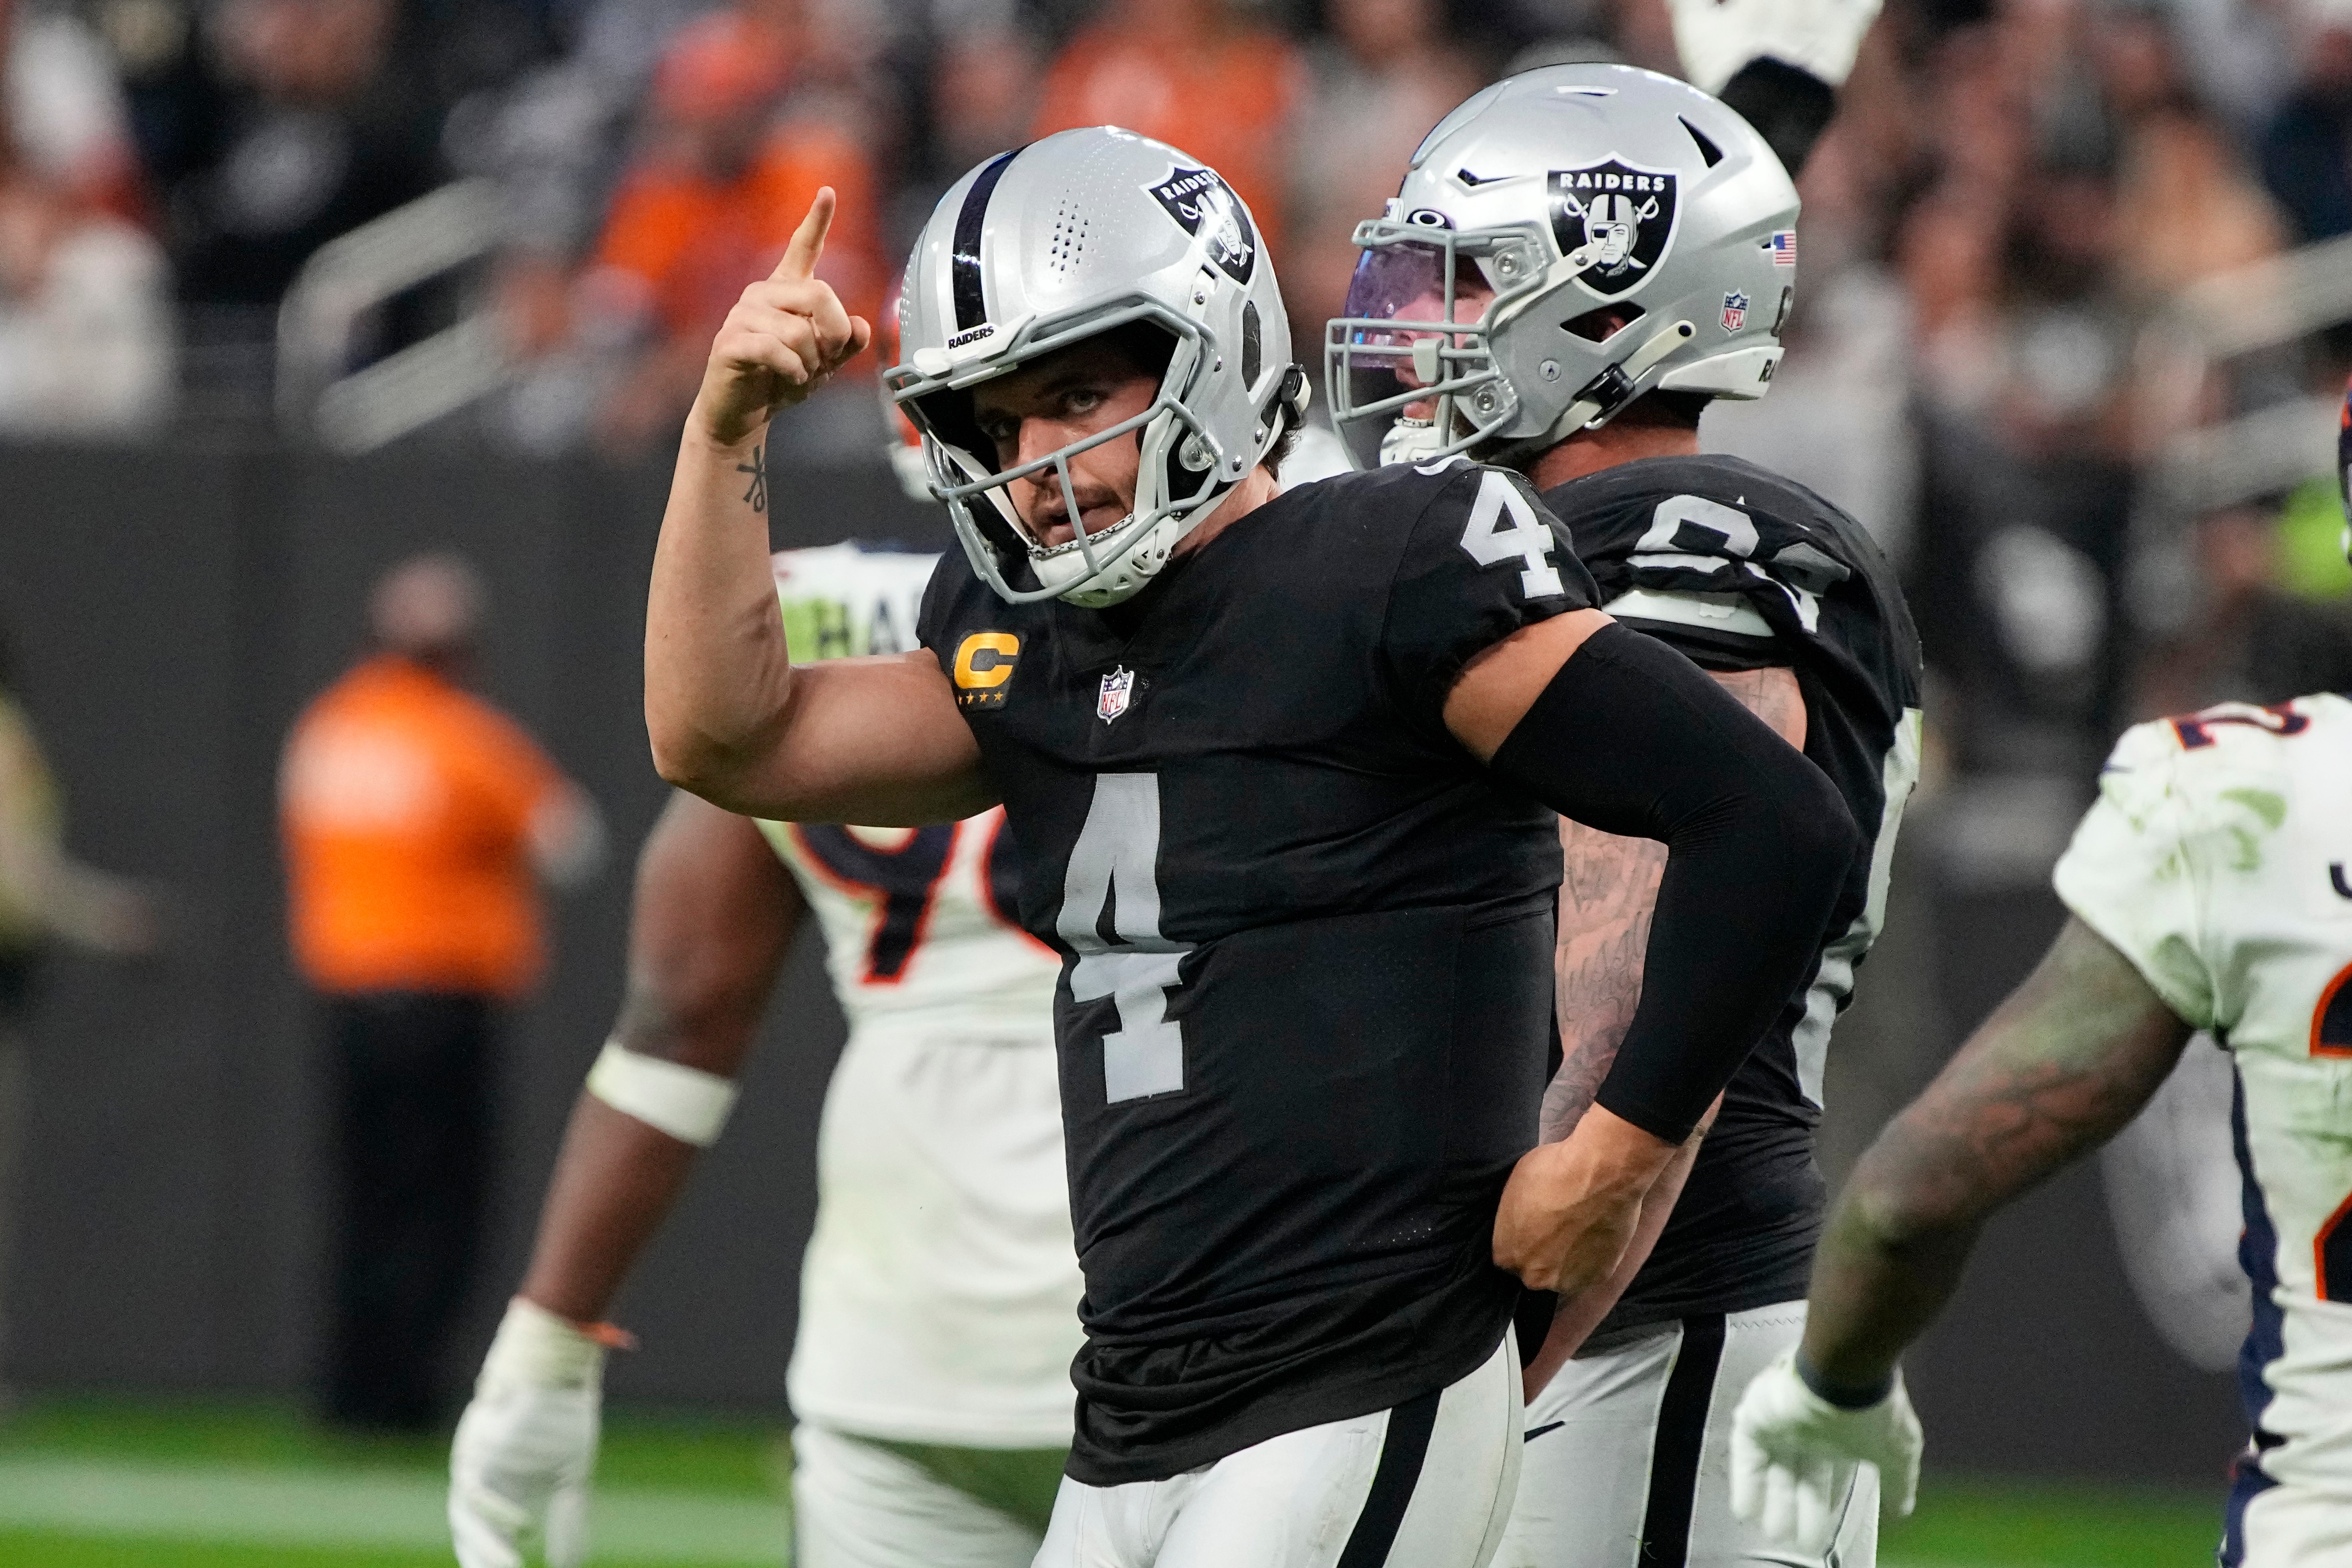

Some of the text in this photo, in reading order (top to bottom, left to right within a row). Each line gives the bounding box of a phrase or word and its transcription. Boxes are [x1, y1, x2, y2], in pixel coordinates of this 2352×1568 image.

[1559, 172, 1665, 191] RAIDERS
[1723, 308, 1743, 328] NFL
[948, 326, 994, 349] RAIDERS
[1460, 470, 1565, 599] 4
[954, 632, 1020, 689] C
[1101, 691, 1122, 713] NFL
[1056, 772, 1197, 1104] 4
